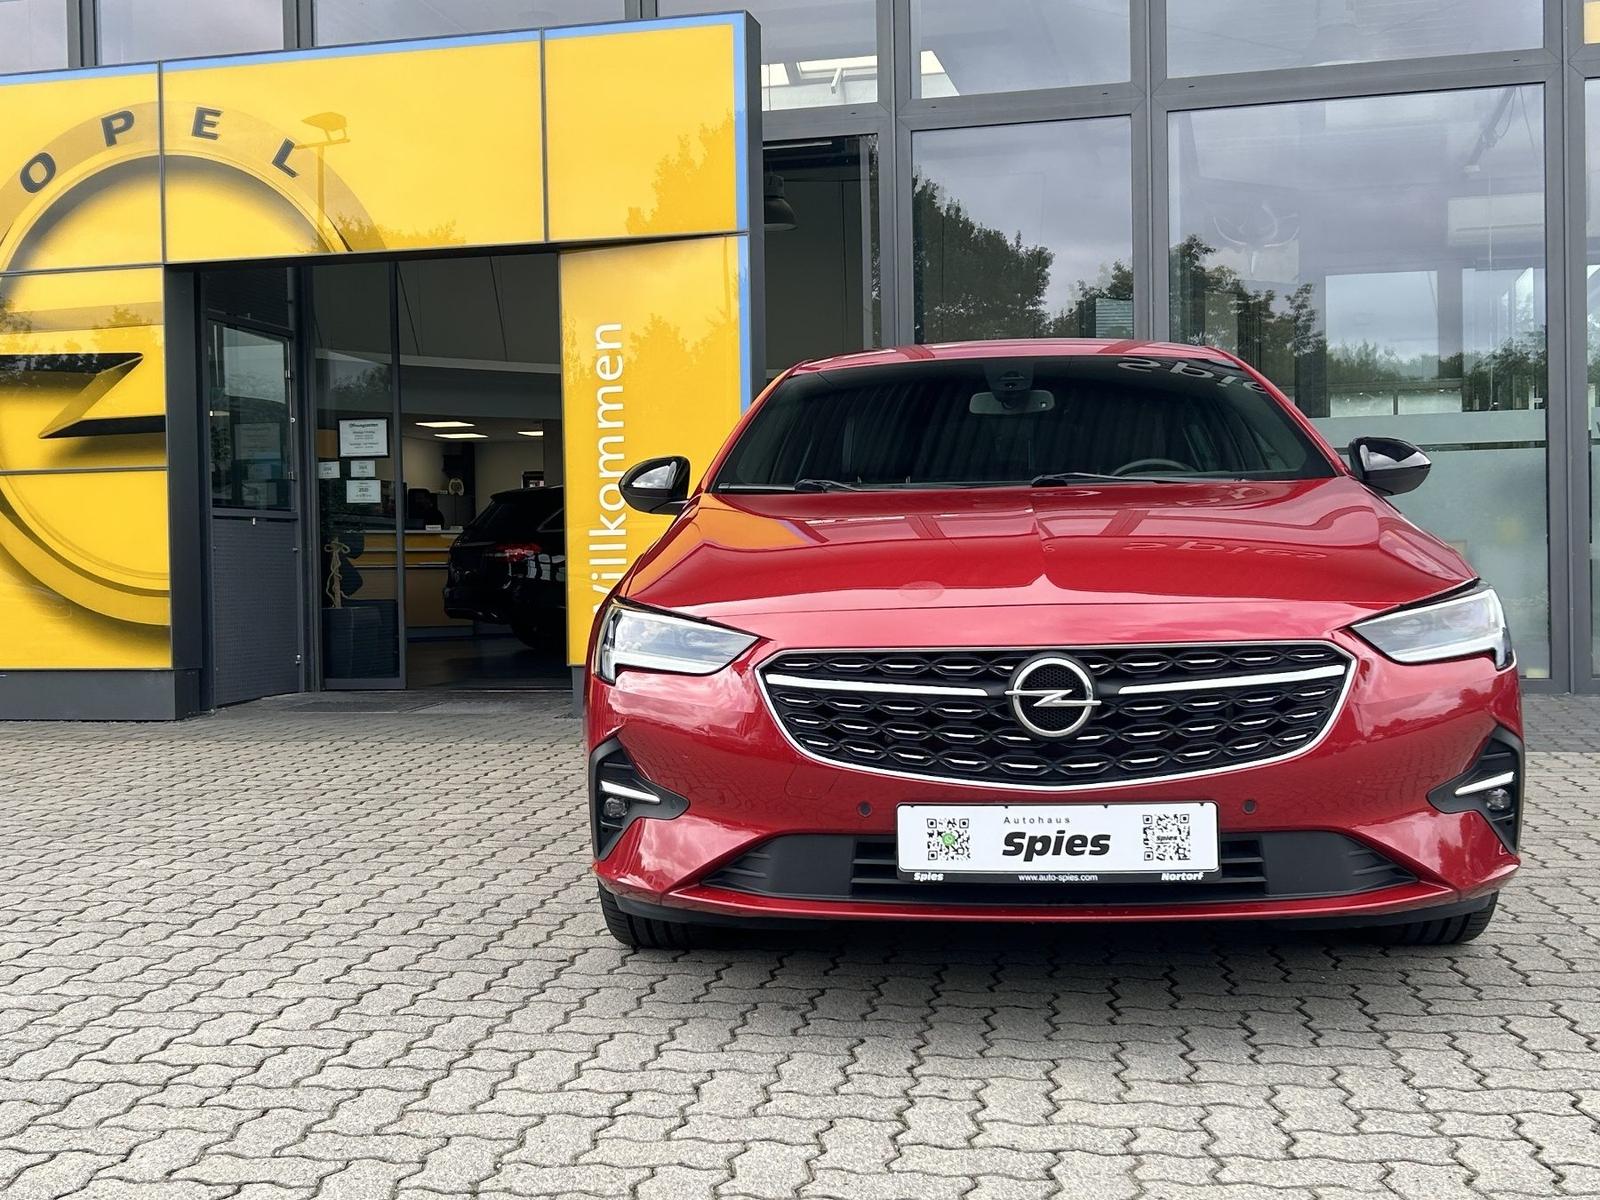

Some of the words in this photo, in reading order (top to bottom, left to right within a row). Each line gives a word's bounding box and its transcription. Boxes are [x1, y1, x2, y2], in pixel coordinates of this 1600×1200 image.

[19, 105, 301, 194] OPEL
[1003, 816, 1071, 824] Autohaus
[1002, 830, 1111, 862] Spies
[913, 872, 944, 882] Spies
[1018, 873, 1099, 883] www.auto-spies.com
[1161, 871, 1205, 882] Nortorf
